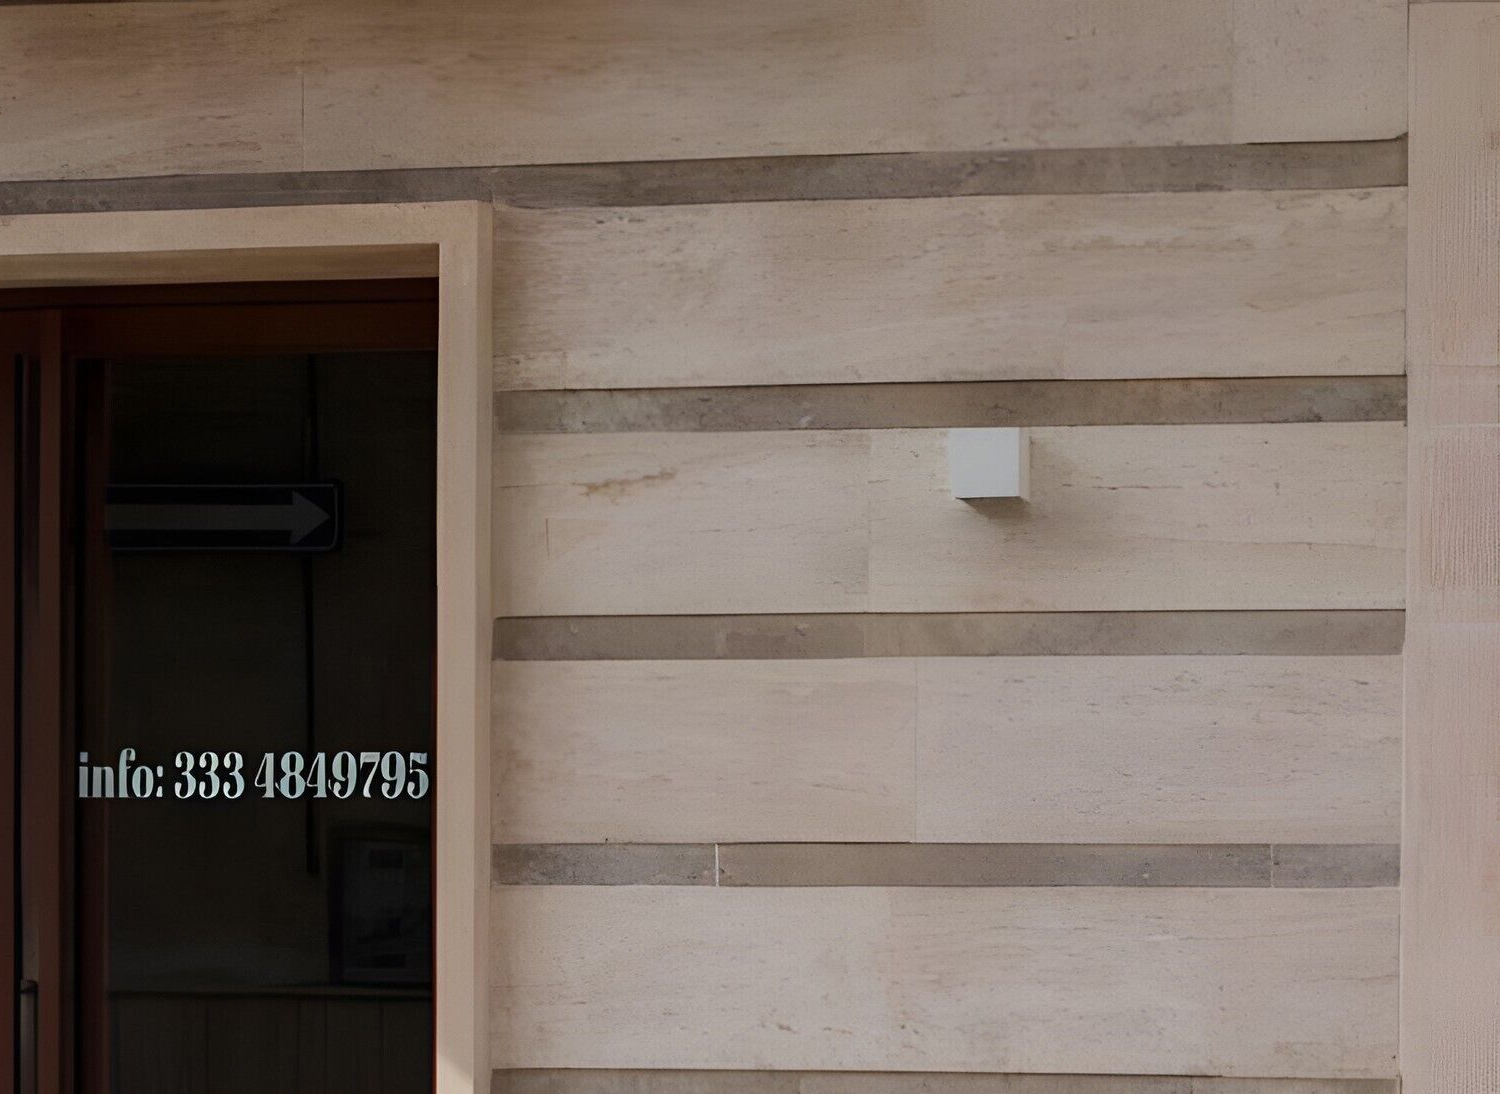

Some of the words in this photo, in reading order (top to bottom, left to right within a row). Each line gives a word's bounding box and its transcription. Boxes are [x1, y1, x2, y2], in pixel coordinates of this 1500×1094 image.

[78, 748, 164, 798] info:
[174, 751, 246, 799] 333
[253, 751, 430, 799] 4849795
